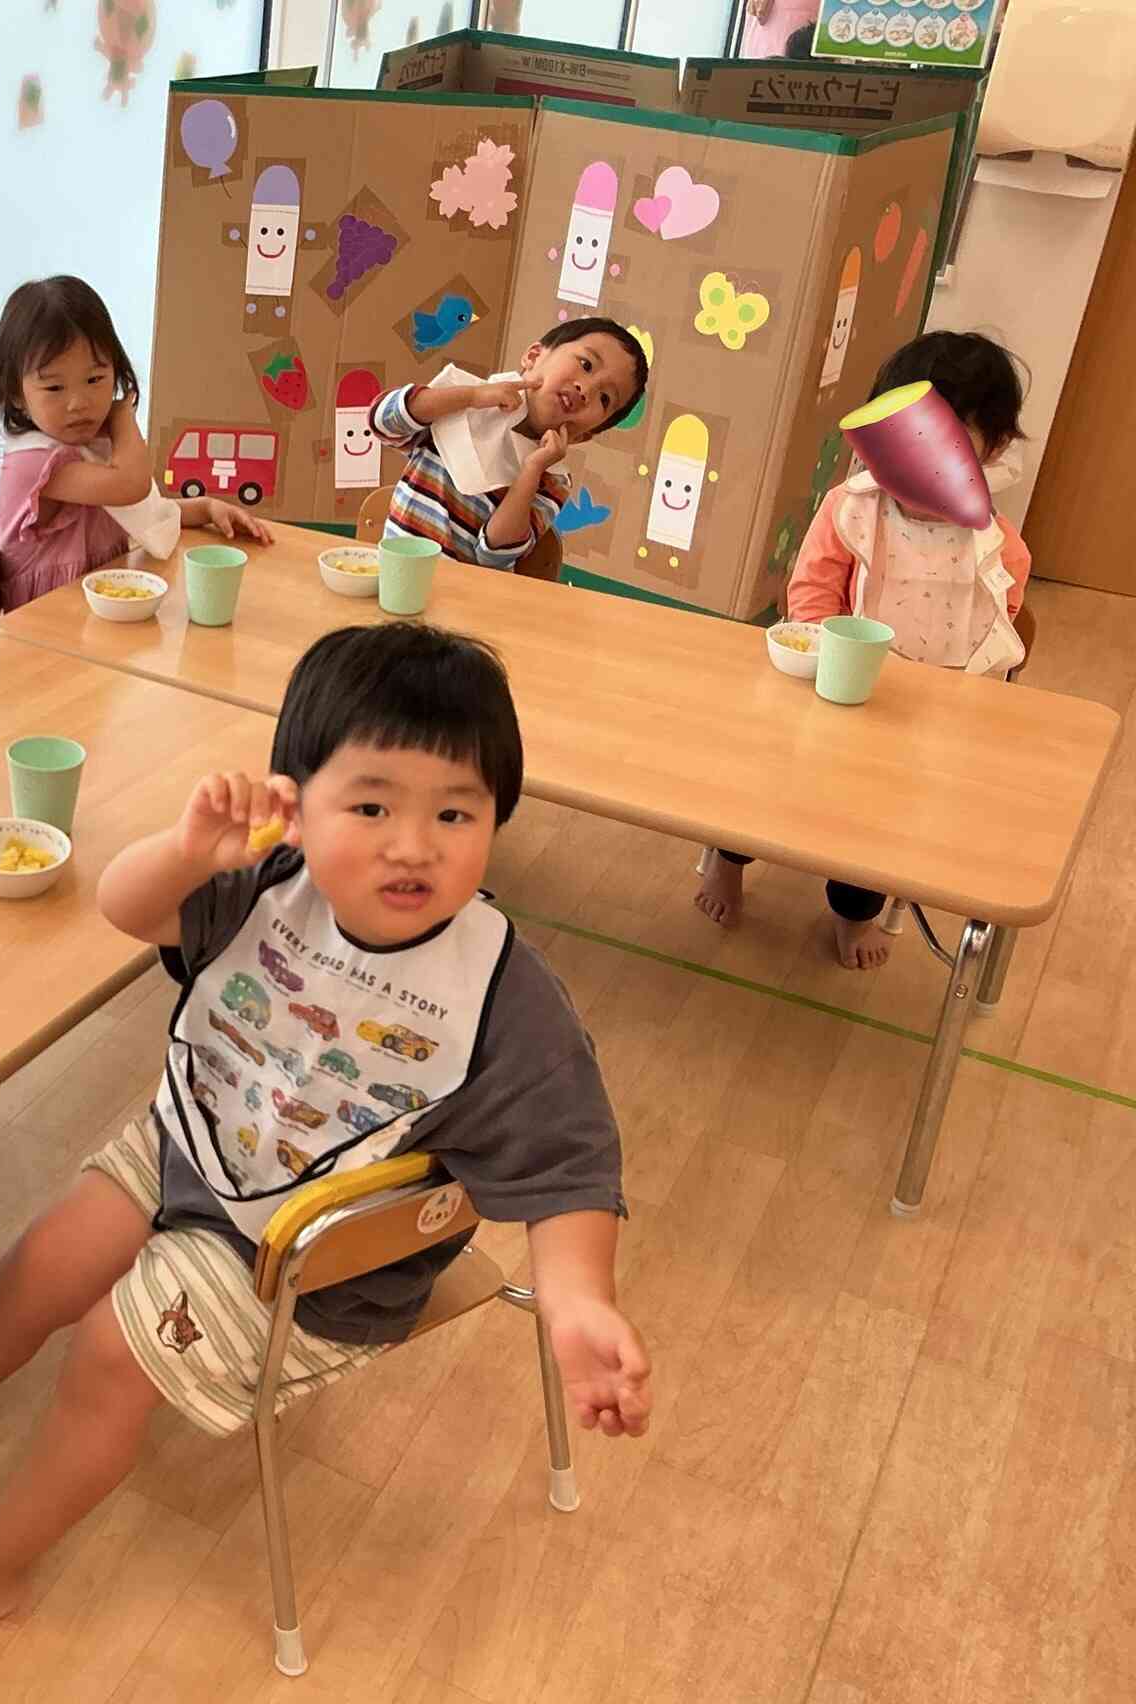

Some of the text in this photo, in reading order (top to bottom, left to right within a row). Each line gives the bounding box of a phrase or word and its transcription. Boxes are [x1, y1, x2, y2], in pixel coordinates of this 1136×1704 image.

[271, 918, 310, 954] EVERY
[312, 951, 345, 971] ROAD
[350, 967, 377, 986] HAS
[382, 981, 393, 995] A
[399, 989, 449, 1021] STORY
